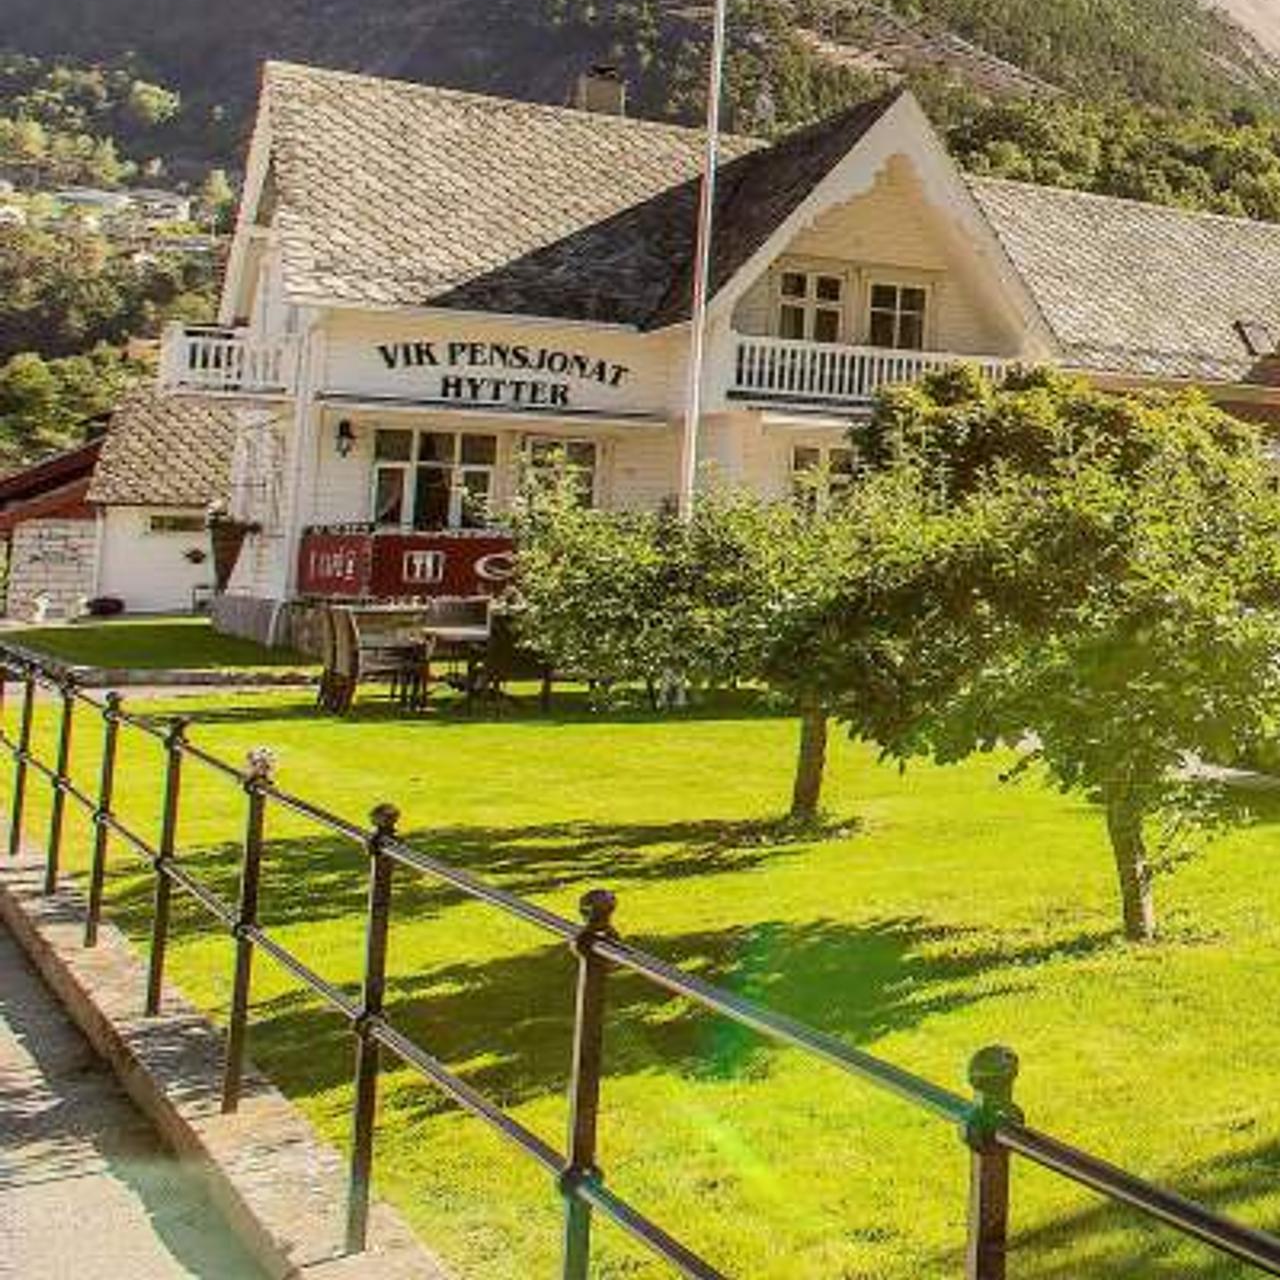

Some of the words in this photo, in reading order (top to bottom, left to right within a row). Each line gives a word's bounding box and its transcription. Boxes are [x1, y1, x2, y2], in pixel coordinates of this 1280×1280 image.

[377, 342, 440, 369] VIK
[447, 342, 629, 387] PENSJONAT
[440, 375, 569, 405] HYTTER
